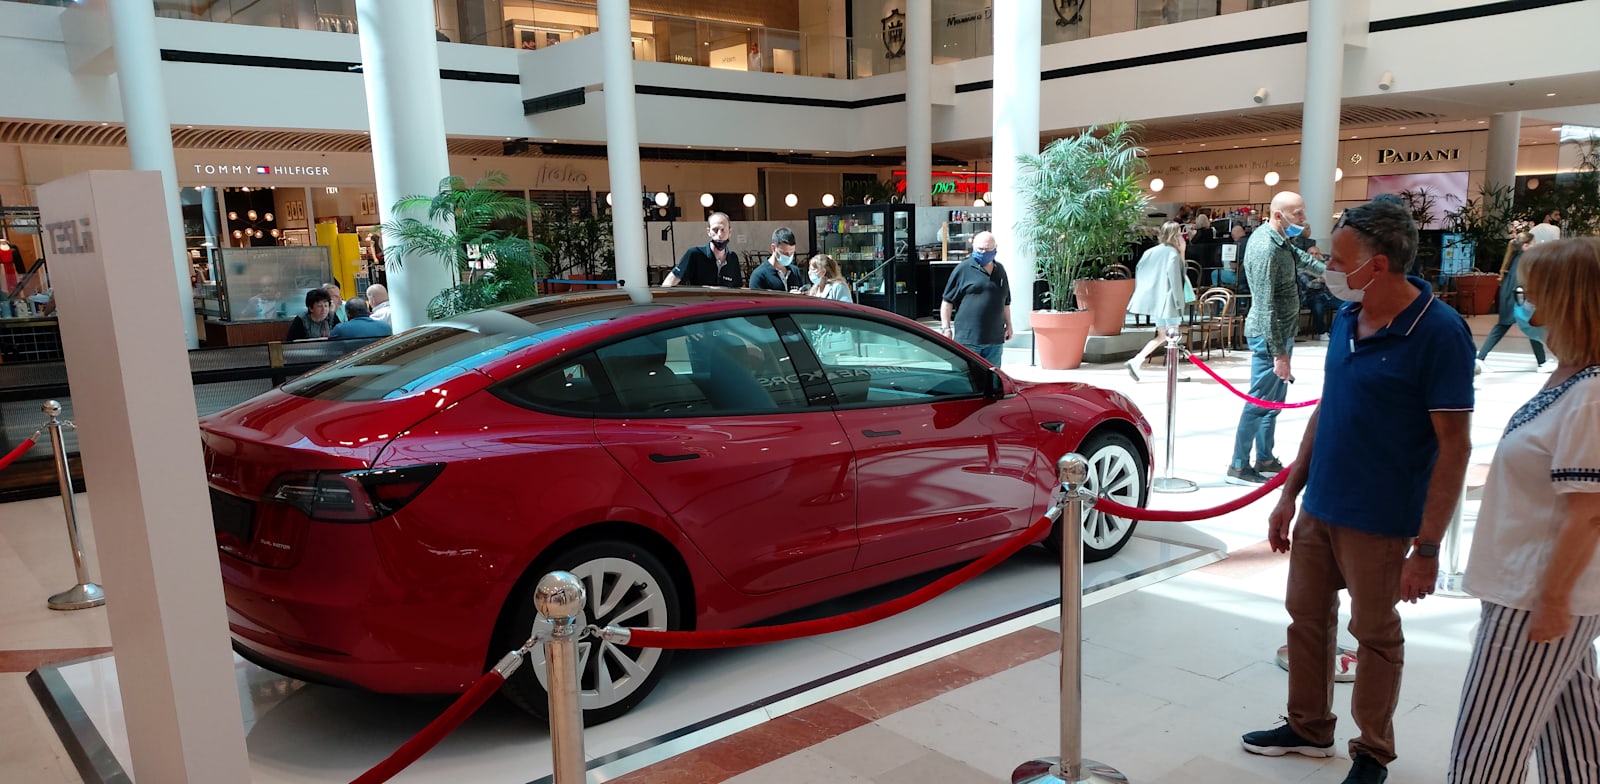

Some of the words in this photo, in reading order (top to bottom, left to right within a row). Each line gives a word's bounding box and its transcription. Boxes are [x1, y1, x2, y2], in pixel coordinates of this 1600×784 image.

[1377, 148, 1461, 165] PADANI
[194, 164, 252, 175] TOMMY
[274, 166, 330, 176] HILFIGER
[1189, 165, 1212, 173] CHANEL
